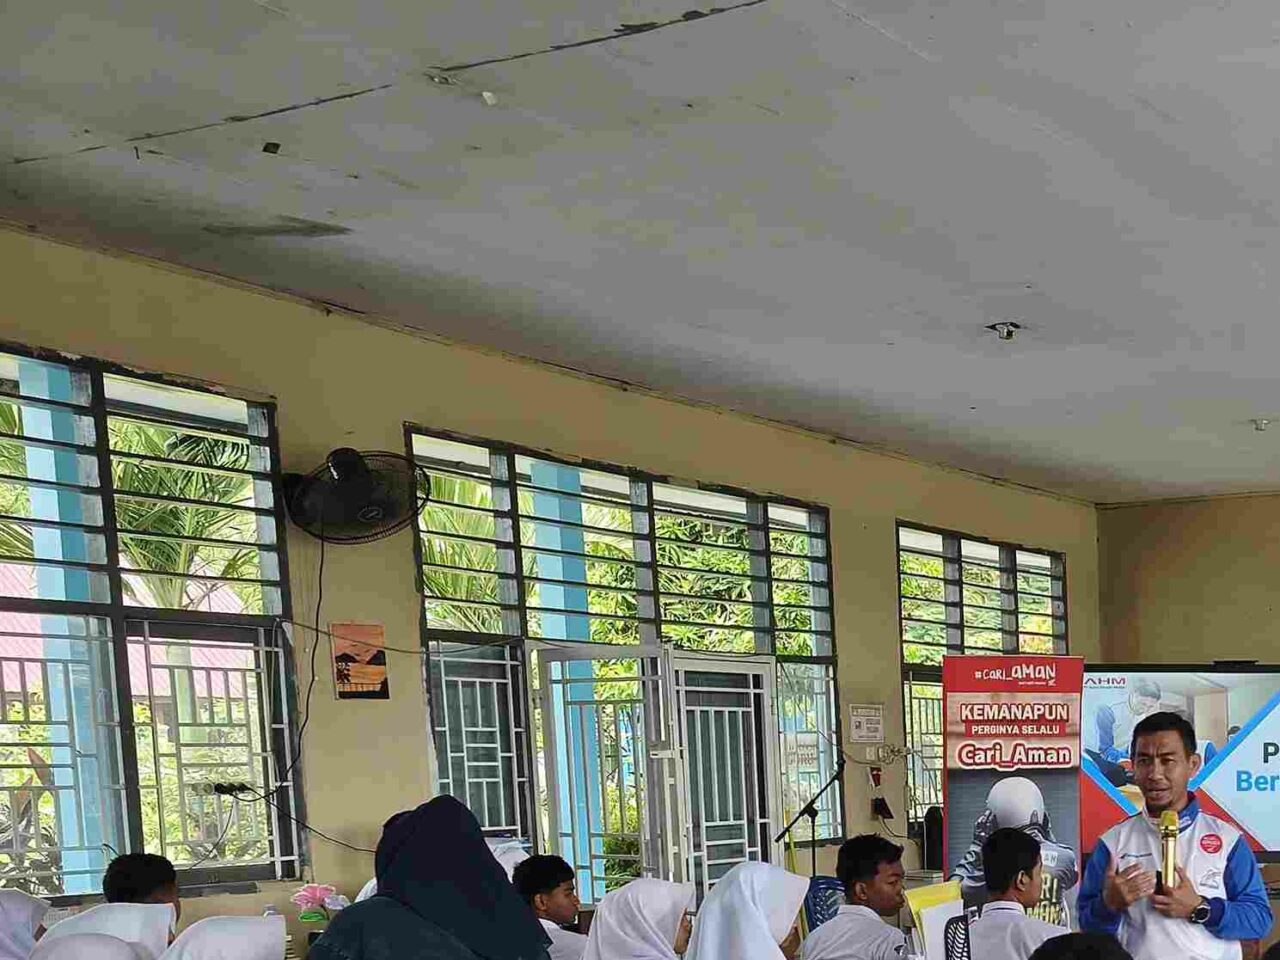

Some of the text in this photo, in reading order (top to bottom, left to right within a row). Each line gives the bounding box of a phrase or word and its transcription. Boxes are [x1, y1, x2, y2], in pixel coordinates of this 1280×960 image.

[1084, 677, 1126, 685] AHM
[961, 704, 1068, 720] KEMANAPUN
[972, 725, 1060, 734] PERGINYA SELALU
[960, 743, 1071, 766] Cari_Aman
